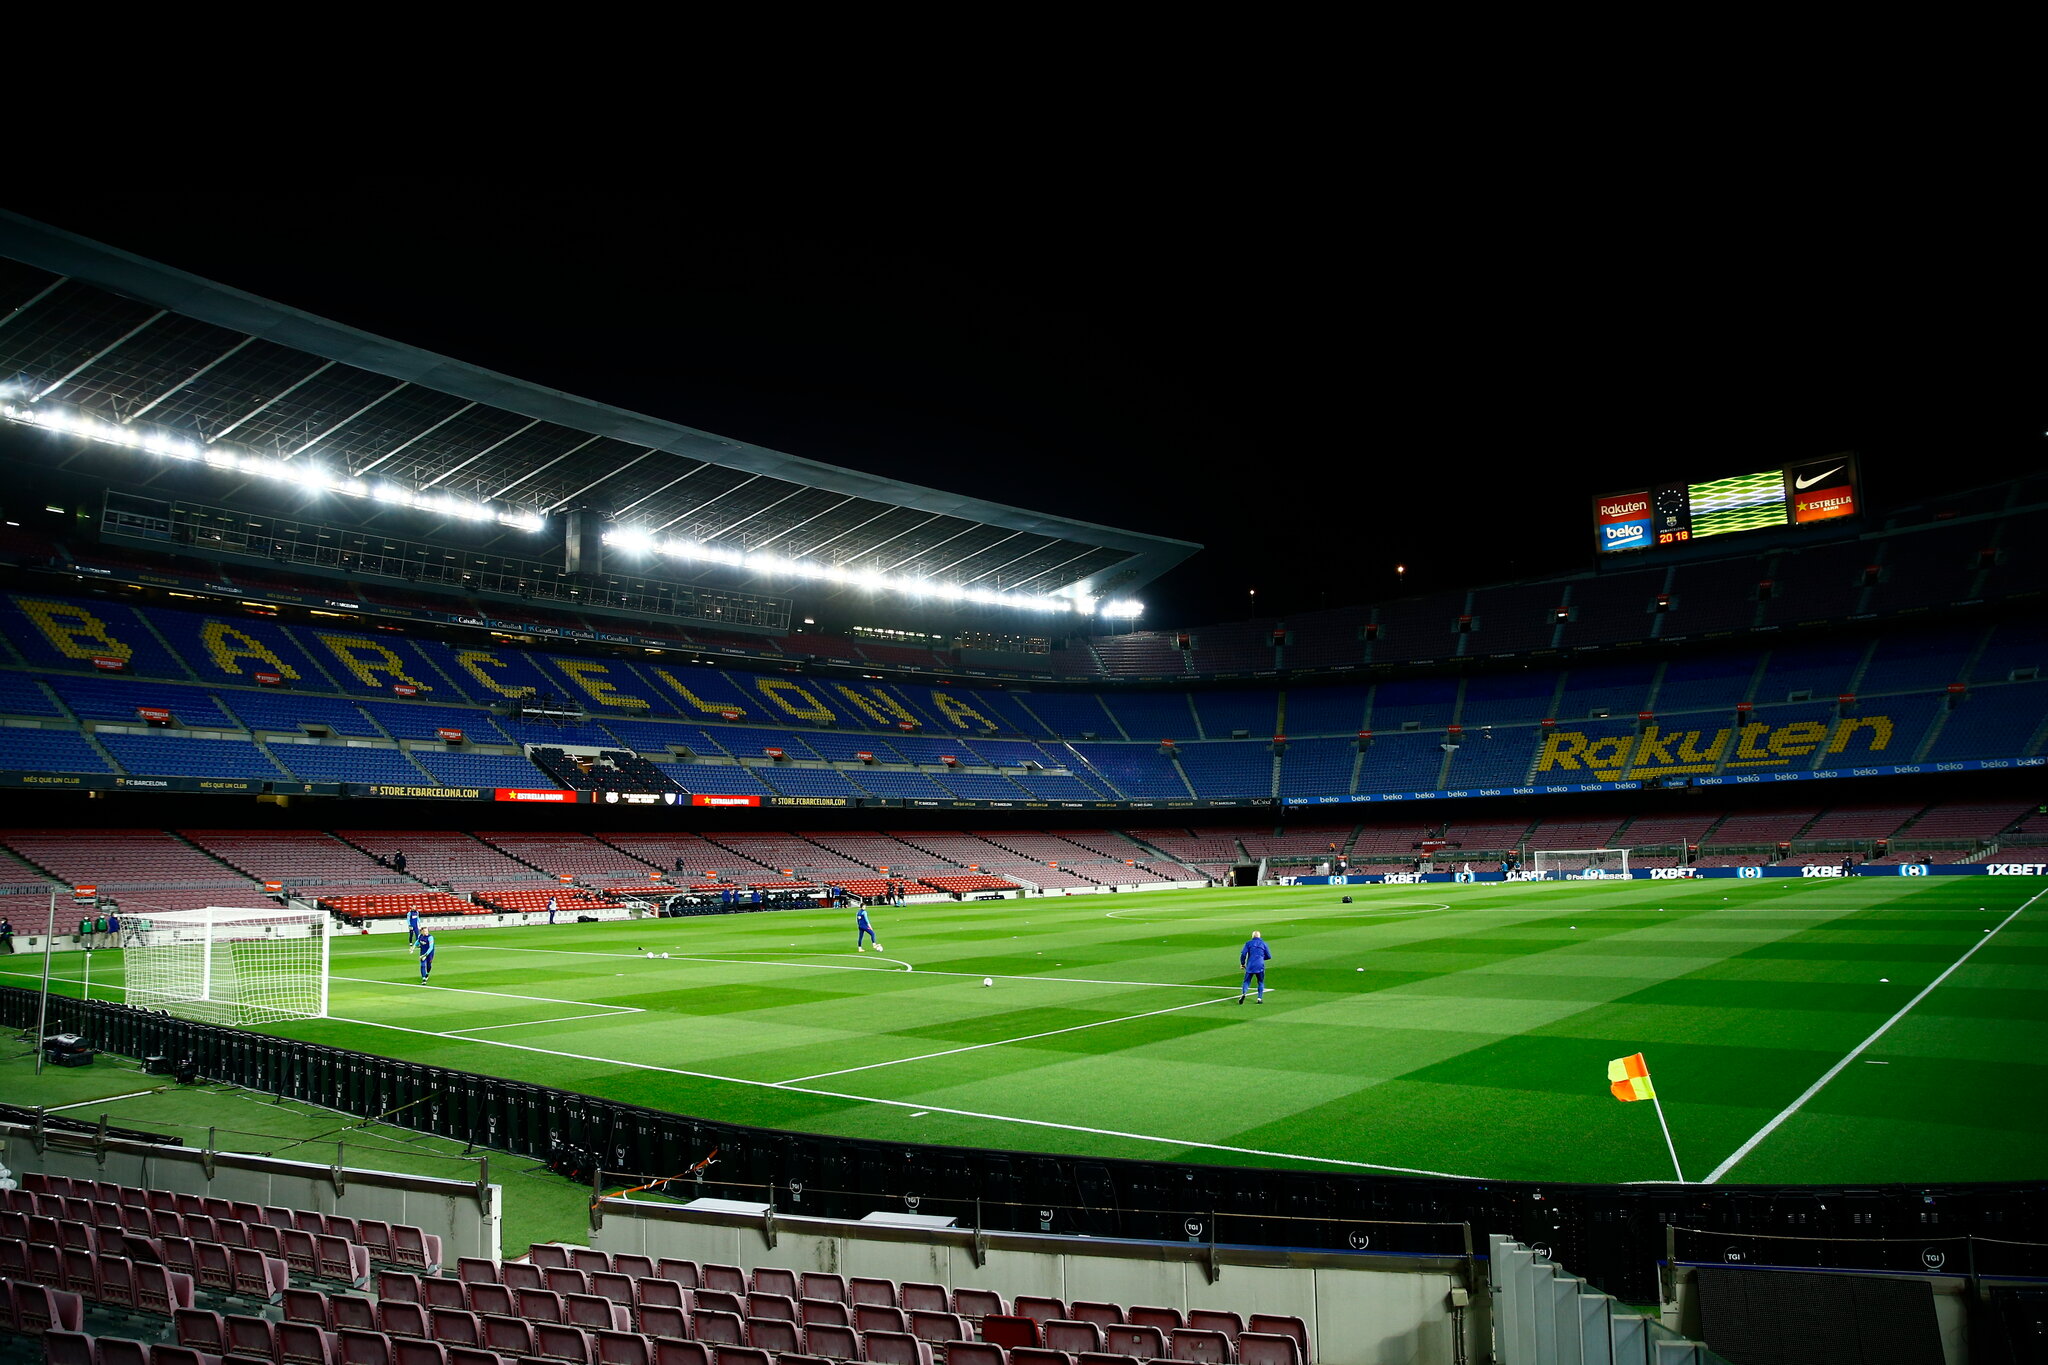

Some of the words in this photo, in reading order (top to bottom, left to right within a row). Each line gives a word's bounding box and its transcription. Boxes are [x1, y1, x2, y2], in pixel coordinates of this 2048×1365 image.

[1601, 501, 1647, 516] Rakuten
[1809, 496, 1852, 510] ESTRELLA
[1606, 525, 1644, 539] beko
[458, 617, 484, 626] CaixaBank
[14, 600, 999, 730] BARCELONA
[1538, 716, 1893, 772] Rakuten
[1289, 796, 1308, 804] beko
[1383, 793, 1402, 801] beko
[1447, 790, 1467, 798] beko
[1513, 787, 1534, 795] beko
[1547, 785, 1568, 793] beko
[1614, 782, 1636, 790] beko
[1700, 777, 1722, 785] beko
[1737, 774, 1760, 782] beko
[1774, 772, 1798, 780] beko
[1813, 770, 1838, 778] beko
[1853, 768, 1878, 776] beko
[1894, 765, 1920, 773] beko
[1936, 763, 1963, 771] beko
[1980, 759, 2008, 768] beko
[2017, 757, 2045, 766] beko
[380, 786, 479, 798] STORE.FCBARCELONA.COM
[778, 797, 846, 806] STORE.FCBARCELONA.COM
[1926, 1254, 1940, 1262] TGI
